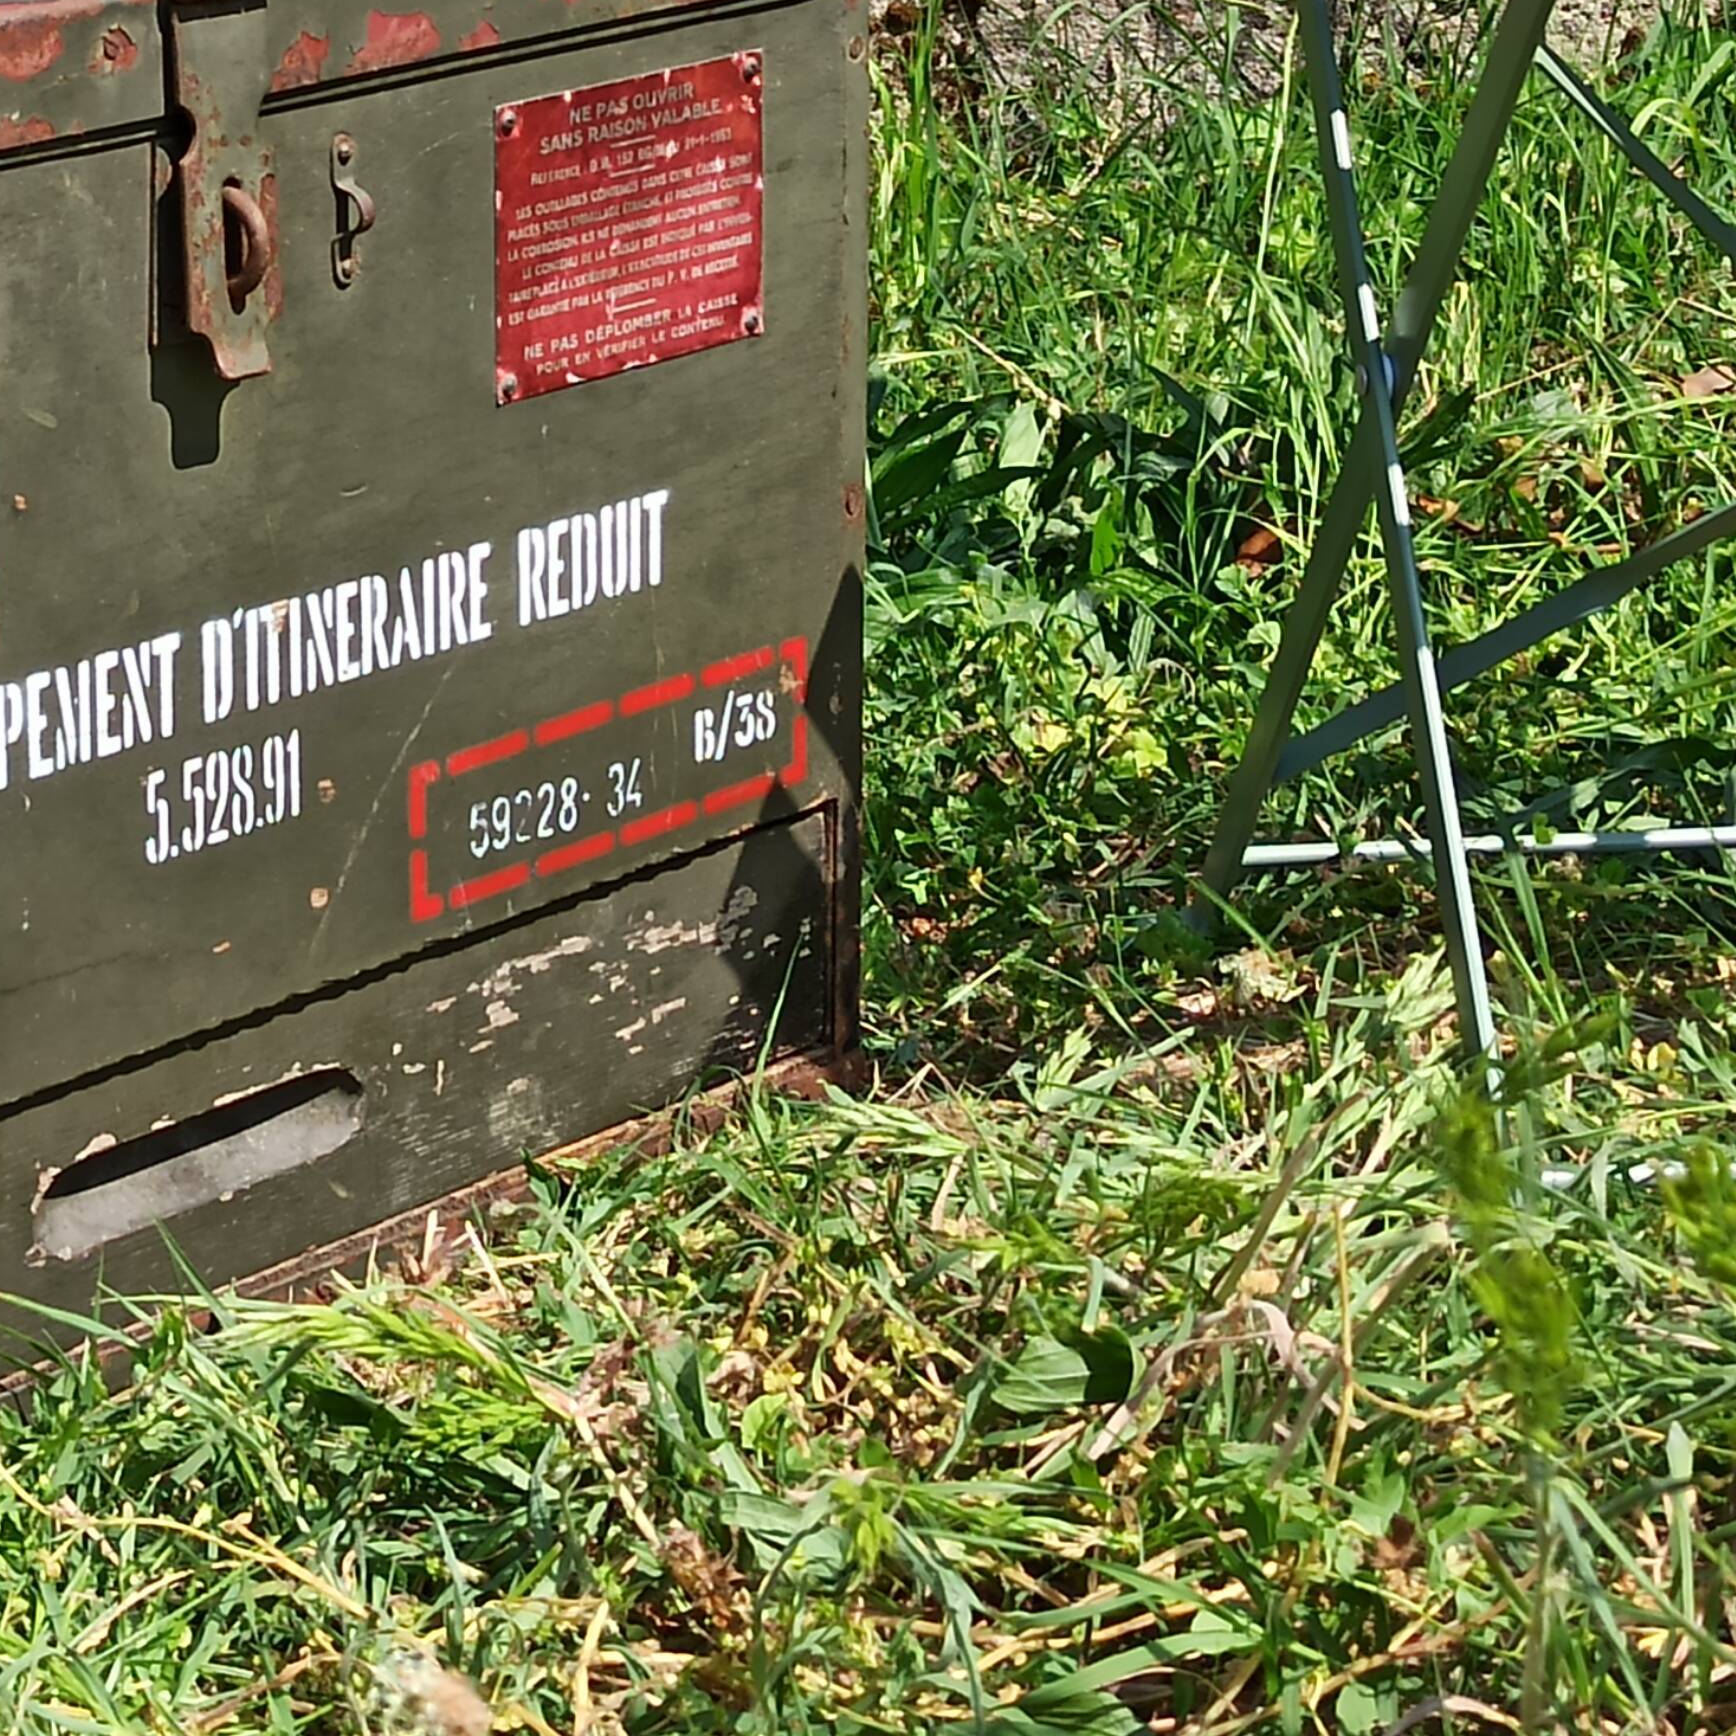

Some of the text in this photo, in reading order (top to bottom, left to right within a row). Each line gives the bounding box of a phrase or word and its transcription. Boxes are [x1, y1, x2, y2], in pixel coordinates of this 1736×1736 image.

[569, 81, 694, 124] NE PAS OUVRIR
[539, 129, 583, 154] SANS
[588, 115, 646, 143] RAISON
[524, 343, 543, 360] NE
[550, 333, 578, 353] PAS
[677, 304, 691, 319] LA
[697, 291, 737, 314] CAISSE
[536, 356, 569, 375] POUR
[575, 350, 590, 364] EN
[651, 330, 666, 344] LE
[200, 541, 494, 724] D'ITINERAIRE
[516, 488, 669, 627] REDUIT
[143, 728, 302, 865] 5.528.91
[607, 758, 644, 817] 34
